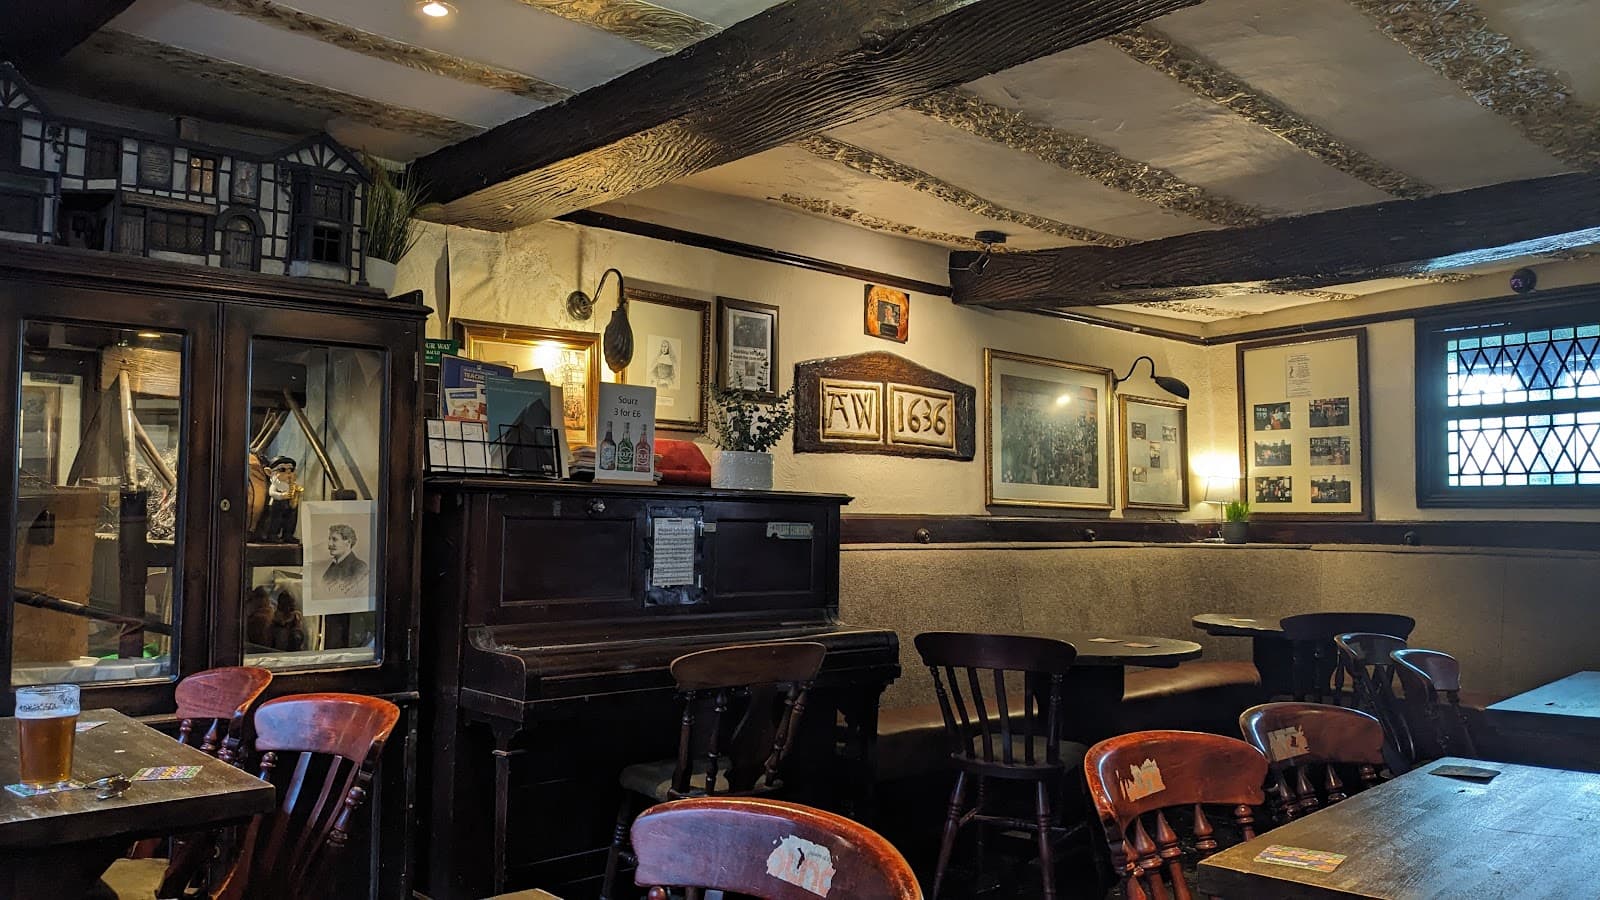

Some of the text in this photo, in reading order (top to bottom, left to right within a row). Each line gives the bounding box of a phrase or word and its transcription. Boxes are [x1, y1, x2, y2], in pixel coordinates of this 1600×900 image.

[618, 395, 638, 405] Sourz
[614, 408, 641, 418] 3 for £6
[827, 391, 947, 436] AW 1636
